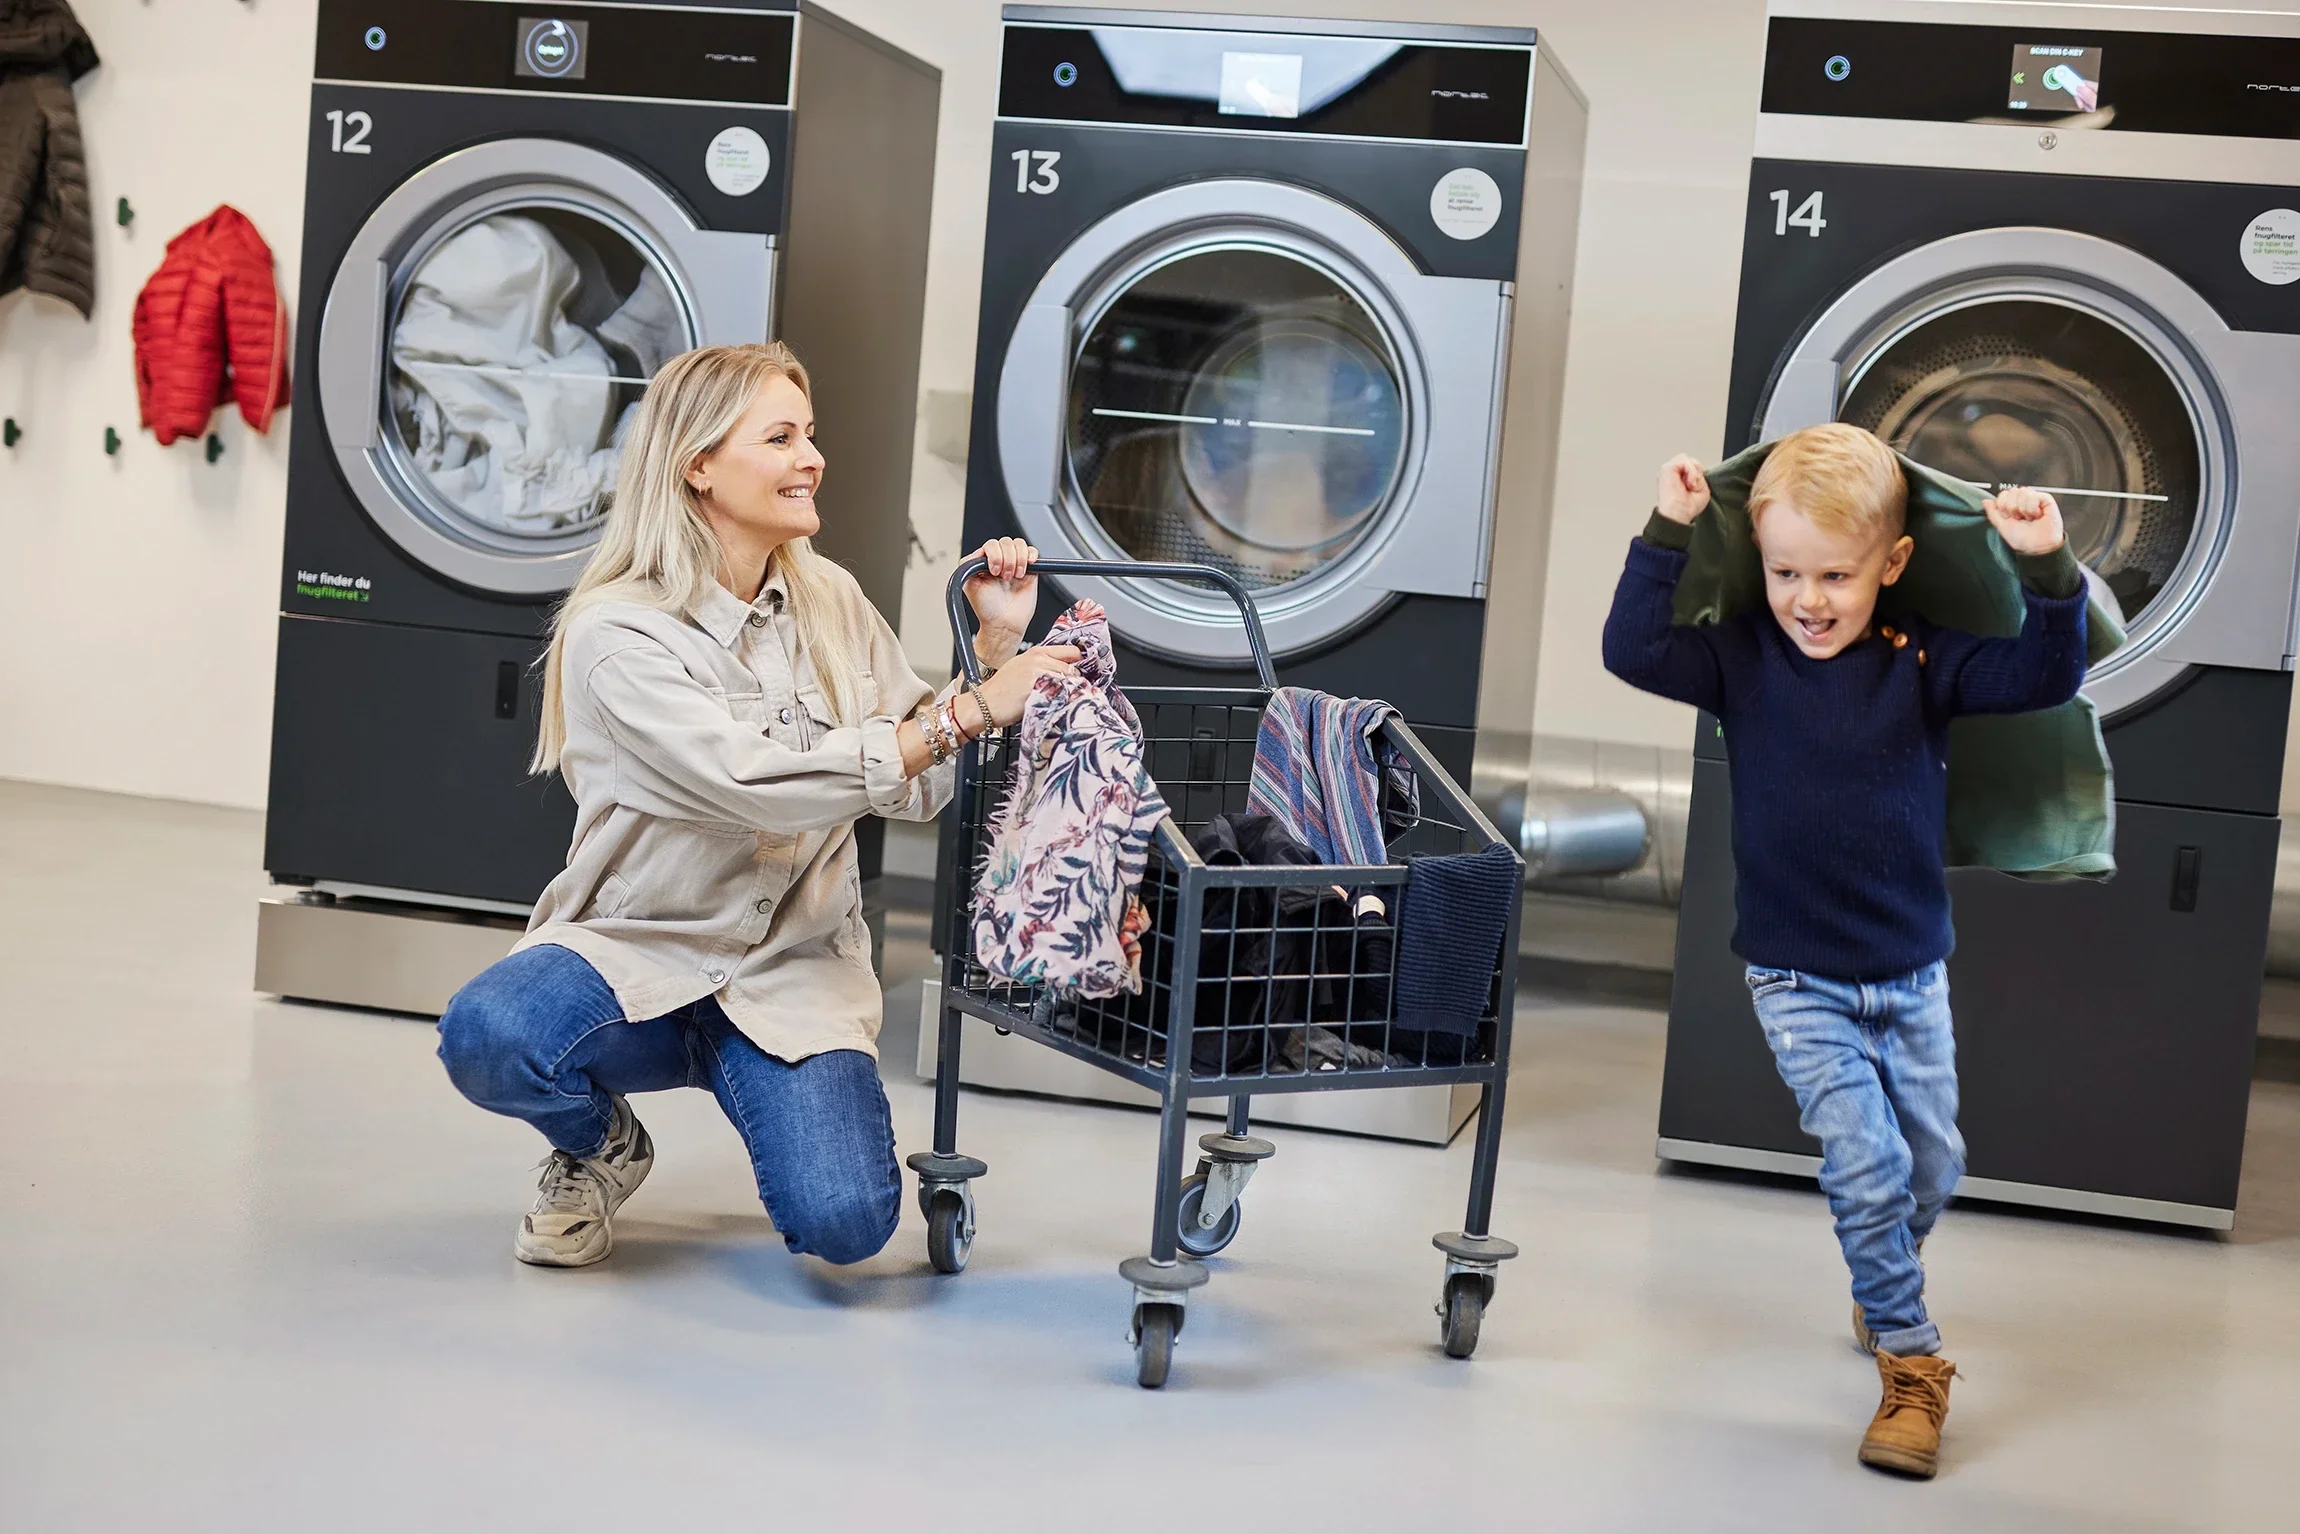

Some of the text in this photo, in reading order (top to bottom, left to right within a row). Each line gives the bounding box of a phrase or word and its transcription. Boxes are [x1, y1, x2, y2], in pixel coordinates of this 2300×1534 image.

[1431, 90, 1489, 99] nortec
[326, 109, 373, 155] 12
[1011, 149, 1061, 195] 13
[1769, 189, 1827, 237] 14
[2254, 232, 2295, 241] fnugfilteret
[2265, 241, 2281, 249] spar
[297, 569, 371, 590] Her finder du
[296, 583, 359, 601] fnugfilteret
